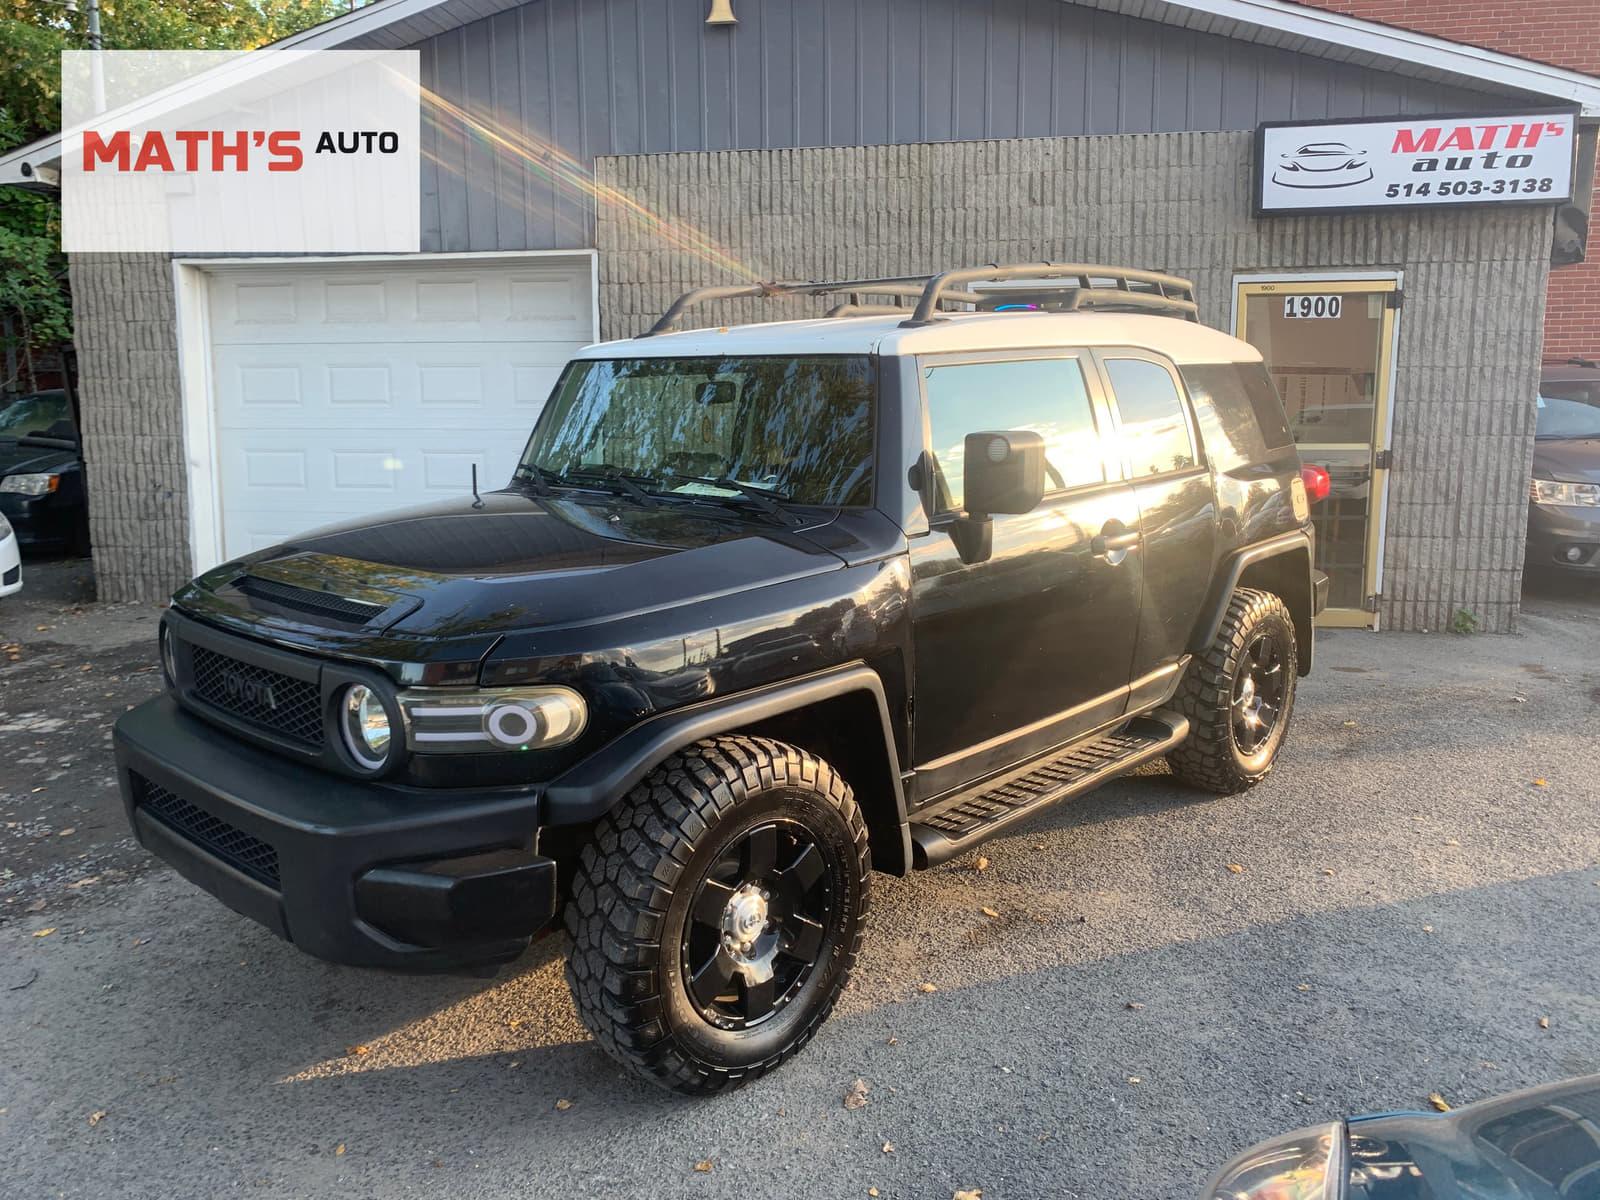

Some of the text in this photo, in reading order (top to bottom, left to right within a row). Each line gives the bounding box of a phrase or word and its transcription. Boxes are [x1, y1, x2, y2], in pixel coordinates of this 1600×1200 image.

[1411, 151, 1534, 173] auto
[1385, 178, 1553, 198] 514 503-3138
[1260, 284, 1276, 292] 1900
[1285, 296, 1341, 318] 1900
